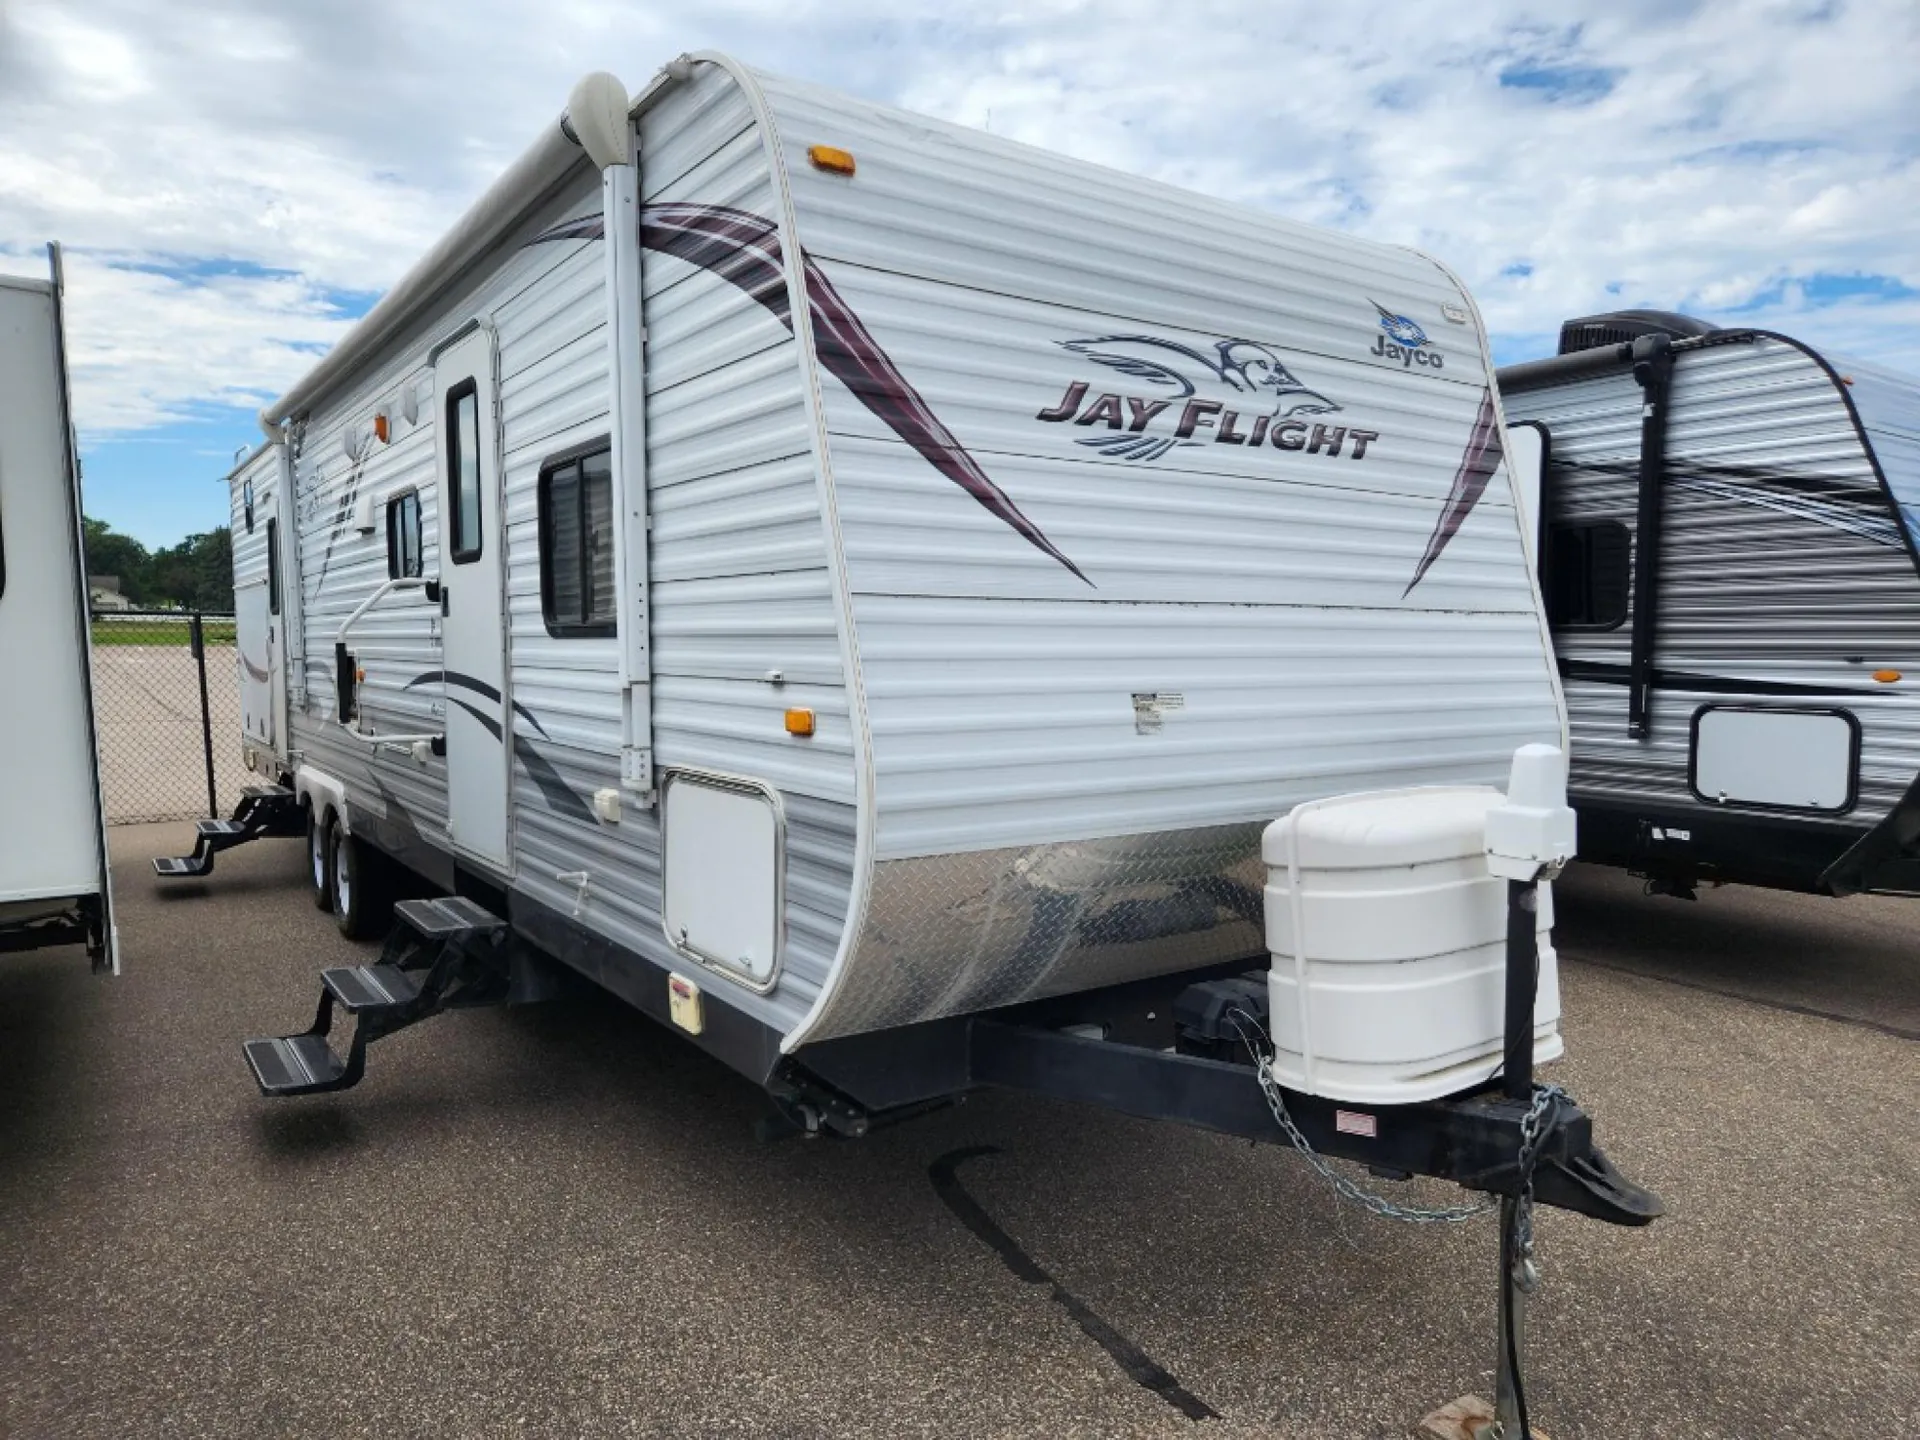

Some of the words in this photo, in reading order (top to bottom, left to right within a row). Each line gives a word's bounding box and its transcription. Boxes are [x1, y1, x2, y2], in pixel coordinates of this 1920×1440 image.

[1371, 335, 1443, 369] Jayco
[1036, 381, 1172, 432] JAY
[1174, 399, 1379, 460] FLIGHT
